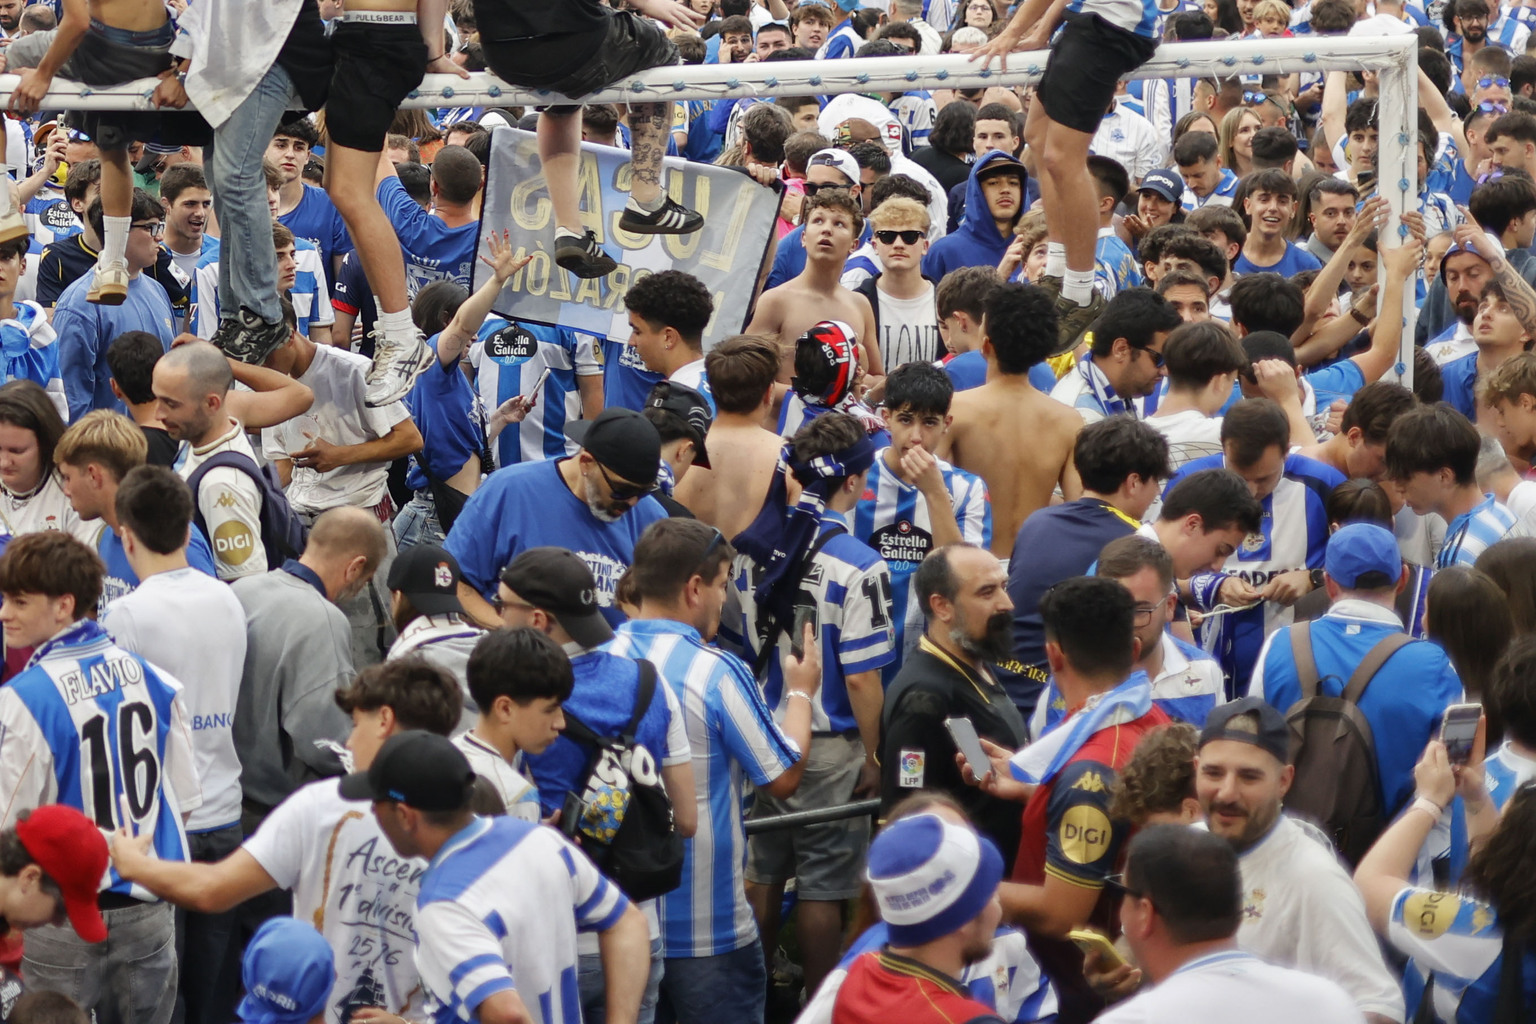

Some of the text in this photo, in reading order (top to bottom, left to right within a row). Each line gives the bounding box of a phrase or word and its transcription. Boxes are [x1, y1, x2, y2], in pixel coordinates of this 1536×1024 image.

[355, 14, 404, 23] PULL&BEAR
[1145, 174, 1174, 189] DEPOR
[492, 333, 530, 345] Esella
[493, 343, 528, 356] Galicia
[820, 342, 835, 368] POR
[216, 533, 251, 552] DIGI
[878, 532, 927, 548] Estrella
[880, 546, 924, 561] Galicia
[59, 656, 141, 706] FLAVIO
[81, 700, 161, 833] 16
[904, 777, 919, 786] LFP
[1063, 822, 1108, 847] DIGI
[1419, 893, 1446, 935] DIGI
